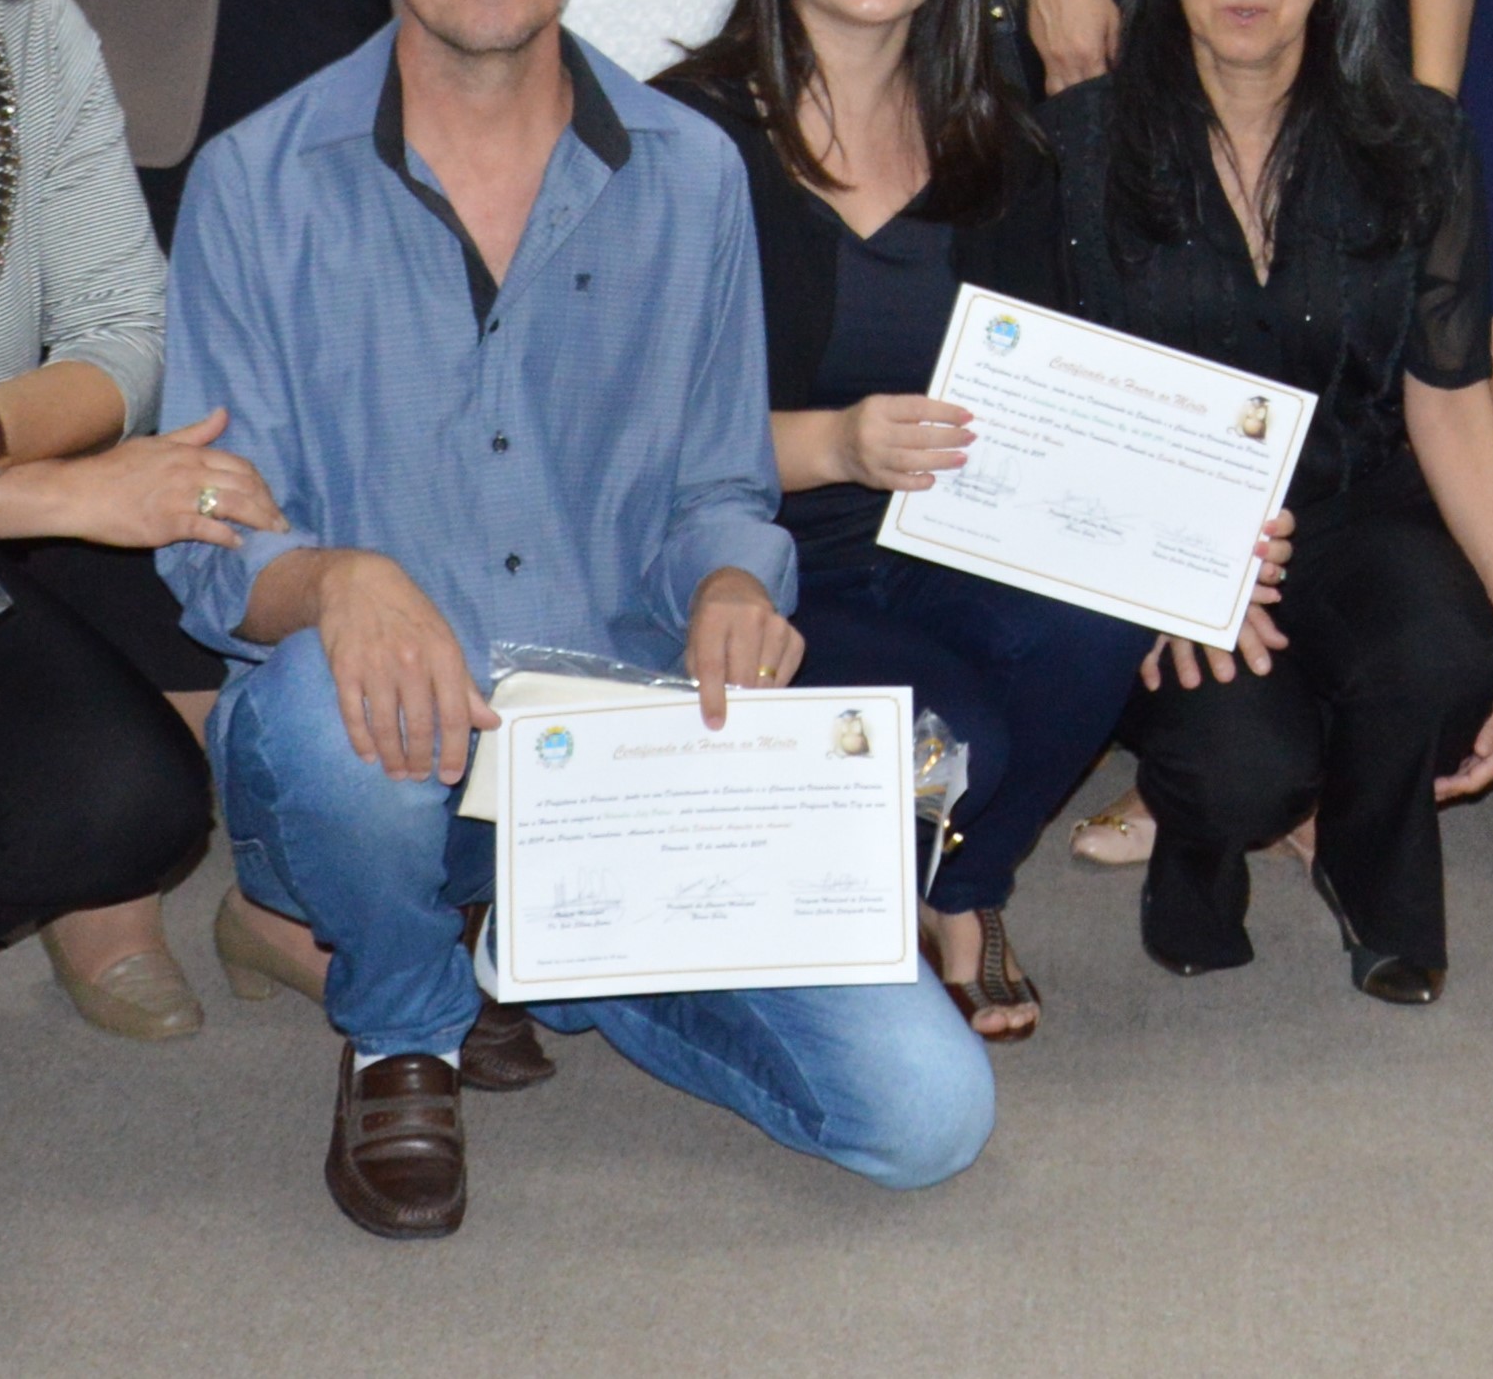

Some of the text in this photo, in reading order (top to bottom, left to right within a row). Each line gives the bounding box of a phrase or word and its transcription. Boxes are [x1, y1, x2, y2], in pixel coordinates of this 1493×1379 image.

[613, 741, 677, 761] Certificado
[682, 740, 694, 753] de
[697, 737, 735, 752] Honra
